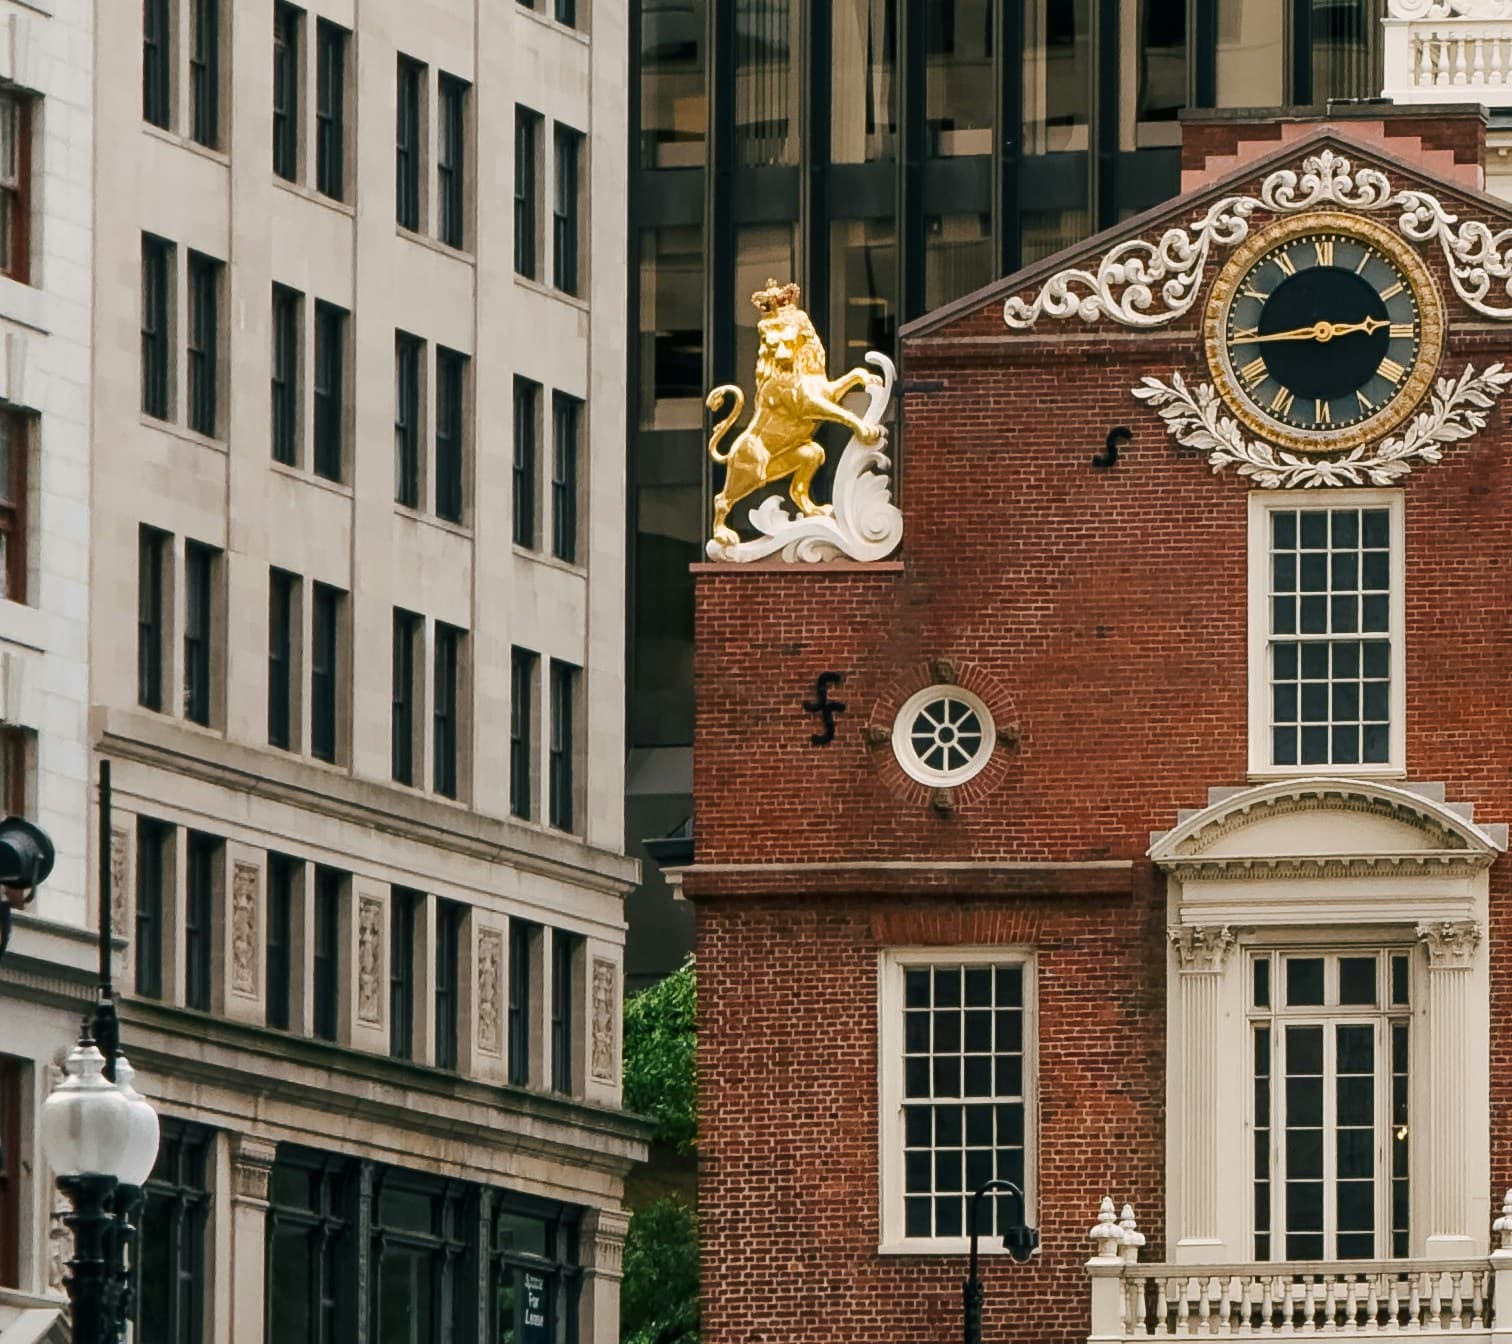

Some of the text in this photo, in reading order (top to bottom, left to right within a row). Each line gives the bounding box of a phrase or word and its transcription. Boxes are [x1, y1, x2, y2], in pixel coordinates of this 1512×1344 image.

[1315, 241, 1334, 267] XII
[1389, 323, 1414, 339] III
[1315, 398, 1331, 424] VI
